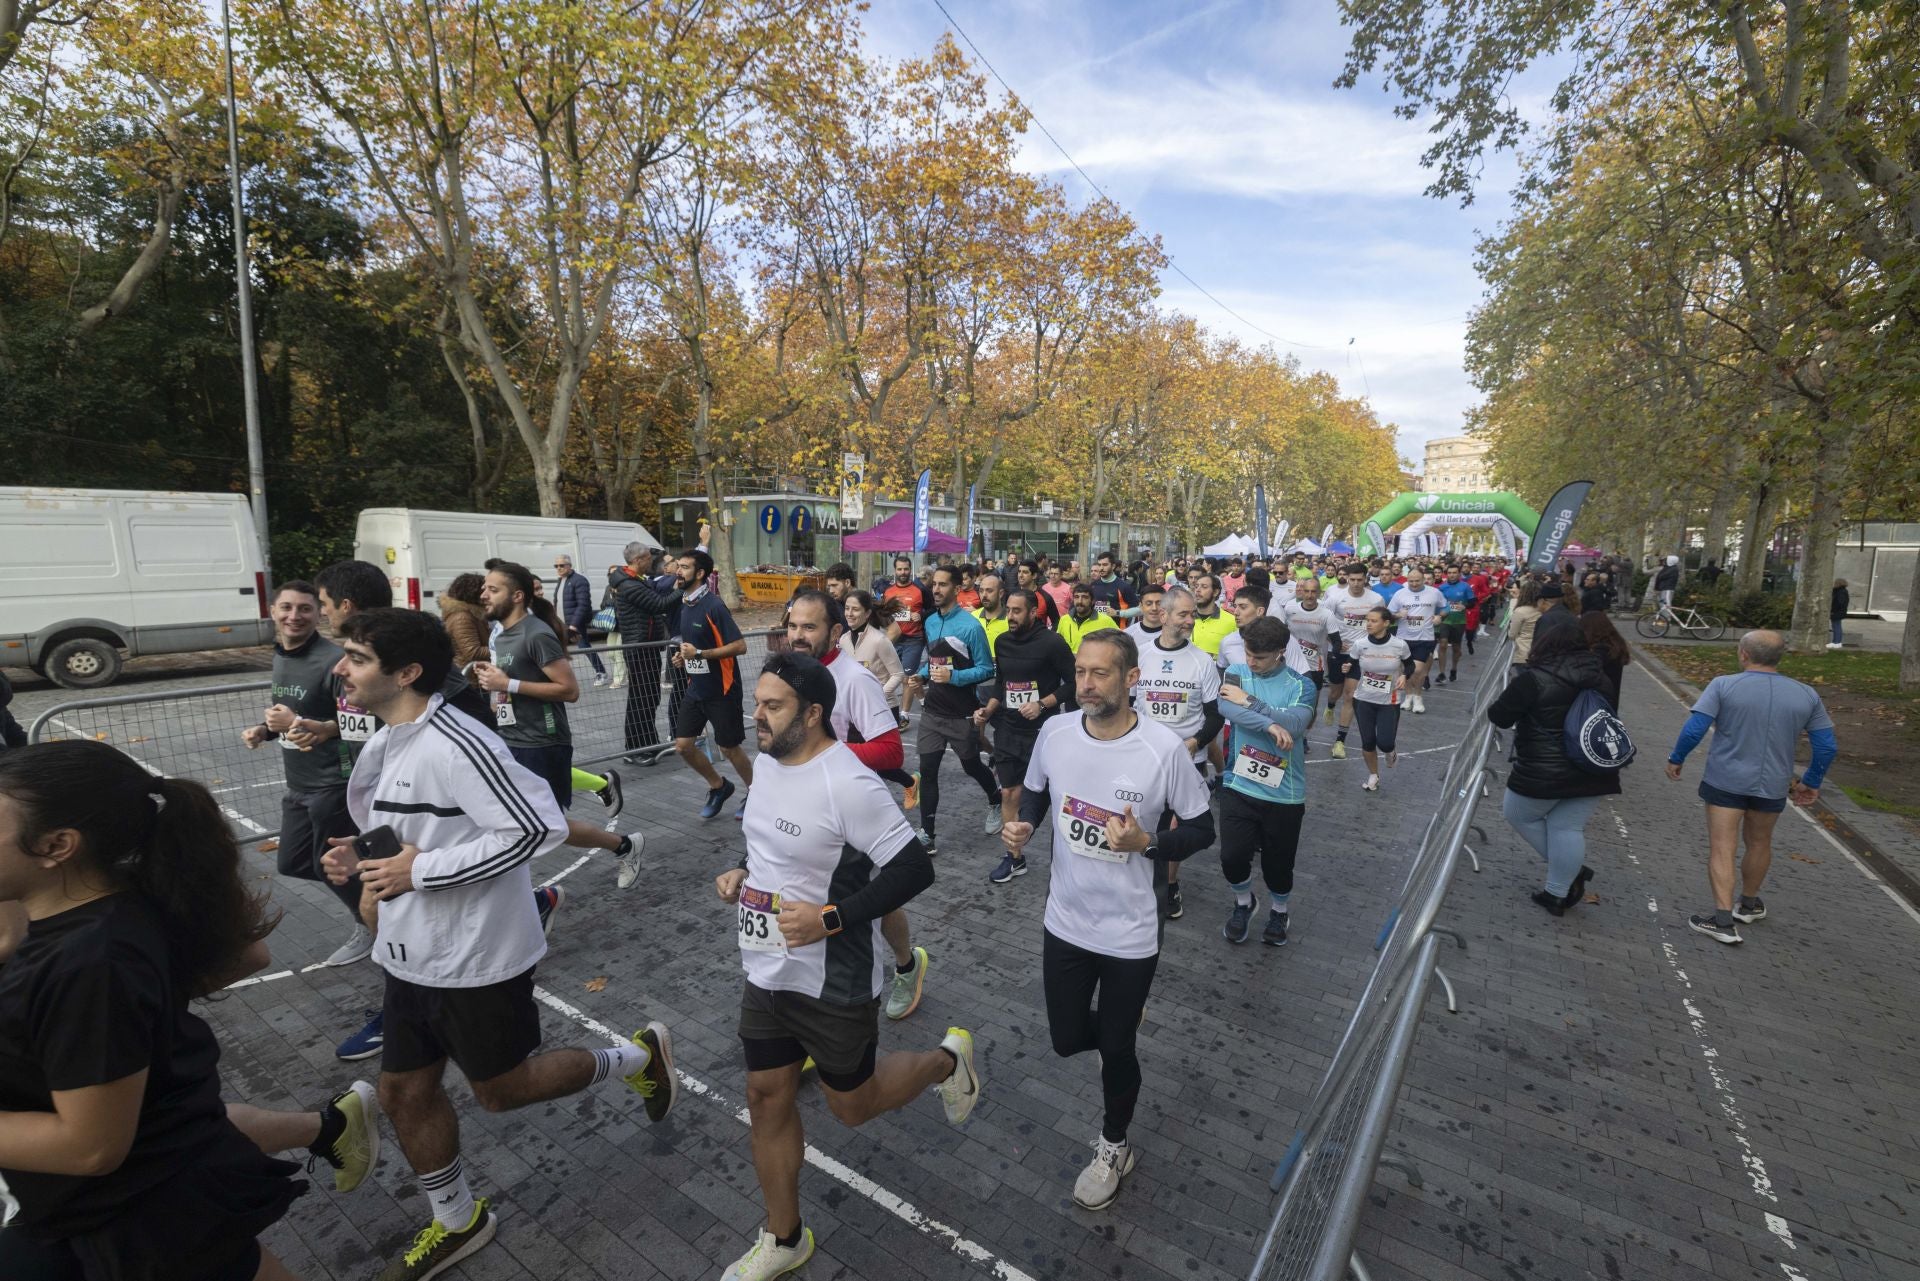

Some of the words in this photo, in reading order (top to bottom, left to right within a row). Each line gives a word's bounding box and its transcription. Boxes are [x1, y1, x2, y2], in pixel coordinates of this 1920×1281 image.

[1441, 499, 1496, 512] Unicaja
[1474, 515, 1500, 523] Castill
[1538, 509, 1573, 563] Unicaja
[1346, 618, 1364, 627] 221
[687, 659, 704, 669] 562
[1137, 679, 1152, 688] RUN
[1154, 679, 1170, 688] ON
[1172, 680, 1197, 690] CODE
[1366, 679, 1386, 689] 222
[1010, 691, 1033, 703] 517
[1151, 702, 1177, 716] 981
[339, 713, 369, 734] 904
[1247, 760, 1271, 778] 35
[739, 906, 769, 939] 963
[387, 942, 407, 962] 11
